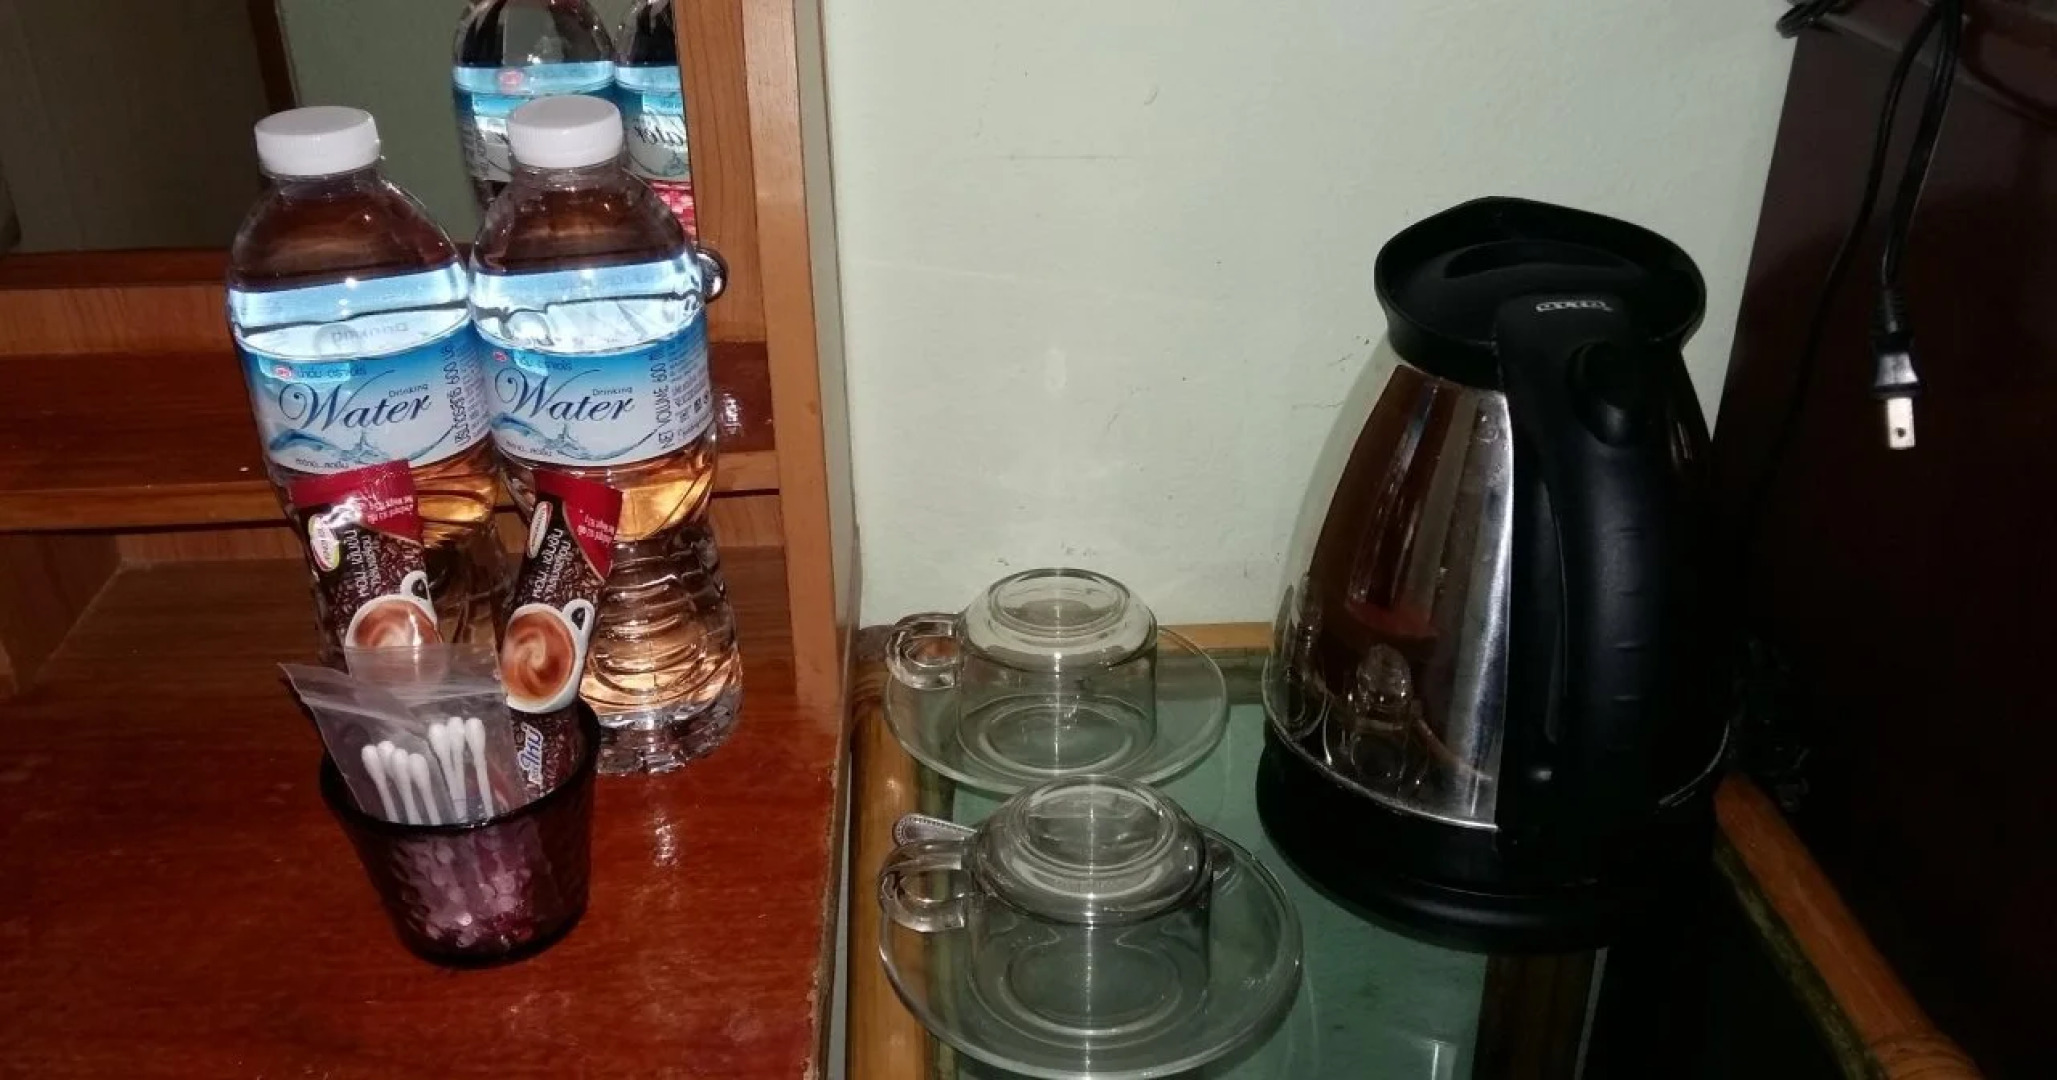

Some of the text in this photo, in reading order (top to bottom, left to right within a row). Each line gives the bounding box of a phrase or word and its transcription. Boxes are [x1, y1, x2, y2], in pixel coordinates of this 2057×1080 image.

[650, 362, 667, 382] 600
[279, 369, 432, 431] Water
[388, 383, 428, 398] Drinking
[495, 367, 636, 421] Water
[592, 386, 633, 397] Drinking
[653, 385, 671, 424] VOLUME
